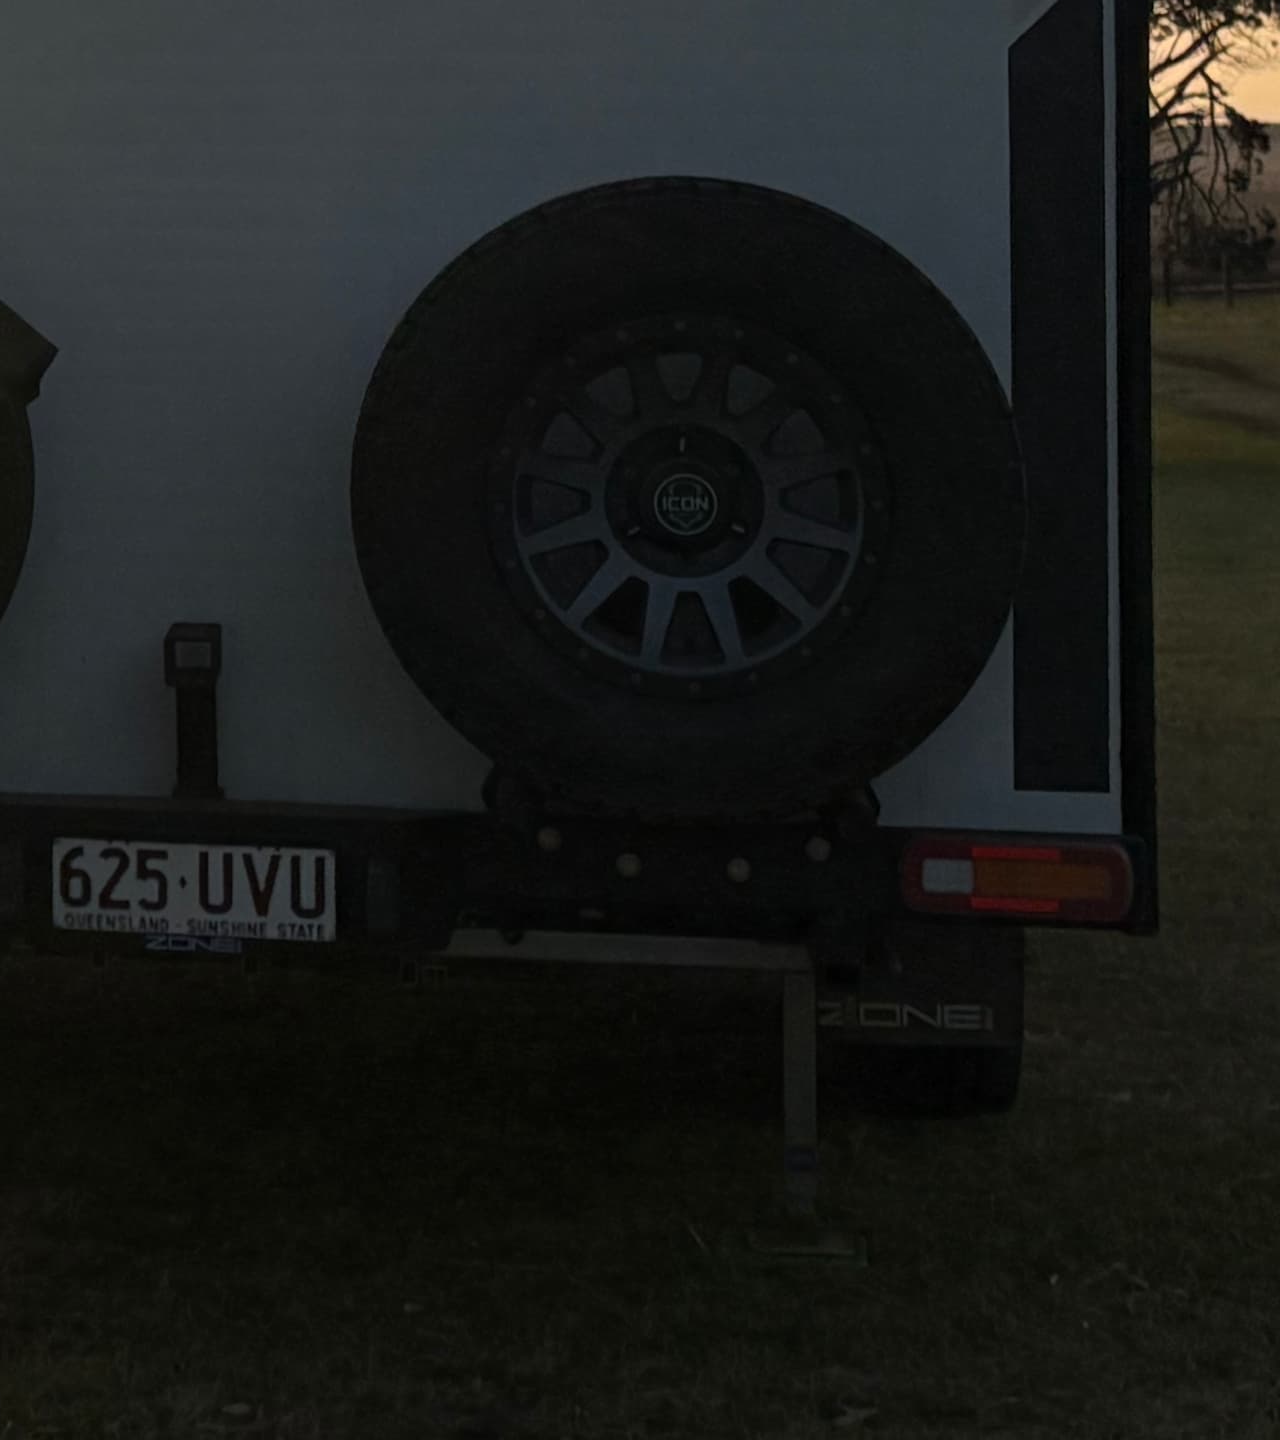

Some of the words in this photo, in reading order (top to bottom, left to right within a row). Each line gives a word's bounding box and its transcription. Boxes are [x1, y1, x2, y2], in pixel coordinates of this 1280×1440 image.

[662, 496, 709, 512] ICON
[63, 913, 170, 933] QUEENSLAND
[186, 918, 267, 937] SUNSHINE
[277, 923, 324, 940] STATE
